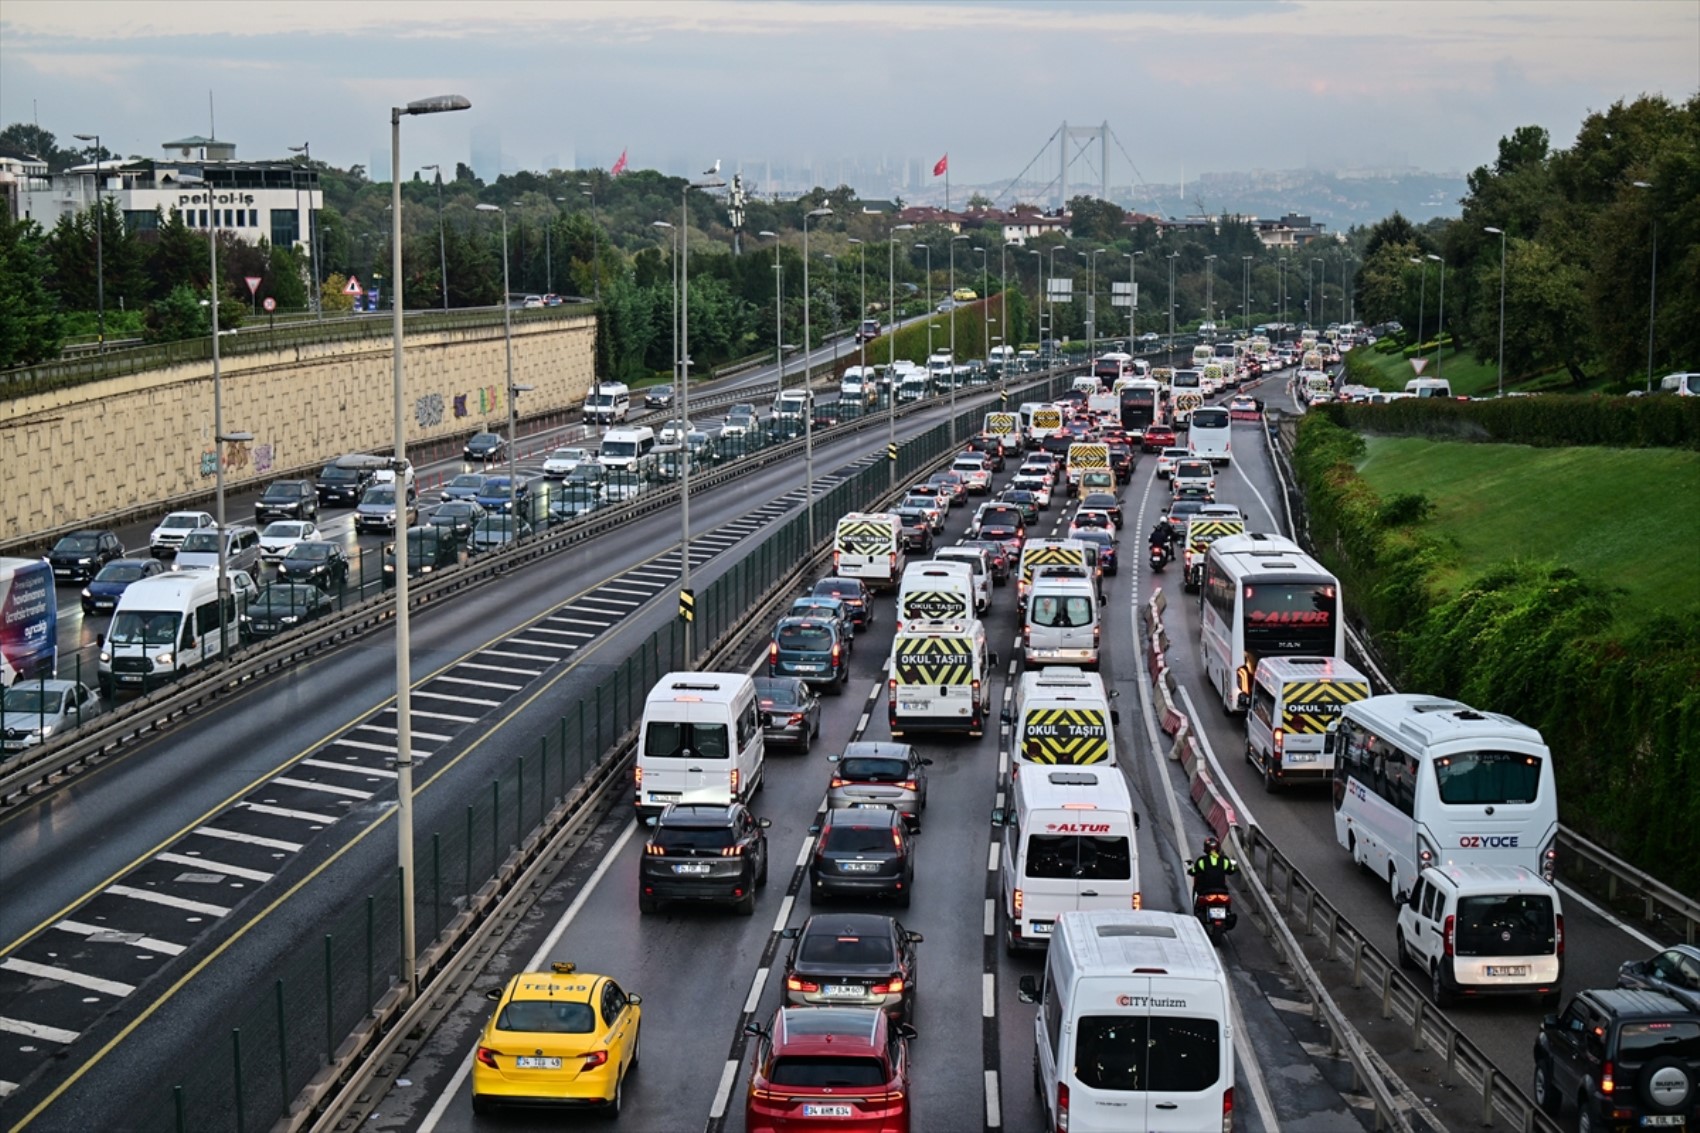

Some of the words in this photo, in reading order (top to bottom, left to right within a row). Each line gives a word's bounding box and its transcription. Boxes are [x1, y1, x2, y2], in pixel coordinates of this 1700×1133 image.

[1264, 610, 1329, 622] ALTUR
[901, 654, 931, 664] OKUL
[935, 654, 967, 665] TAŞITI
[1289, 704, 1321, 712] OKUL
[1027, 725, 1059, 736] OKUL
[1068, 725, 1104, 738] TAŞITI
[1057, 823, 1111, 832] ALTUR
[1120, 996, 1149, 1006] CITY
[1150, 997, 1187, 1008] turizm
[551, 1057, 560, 1066] 49
[809, 1106, 818, 1114] 34
[836, 1106, 849, 1115] 634
